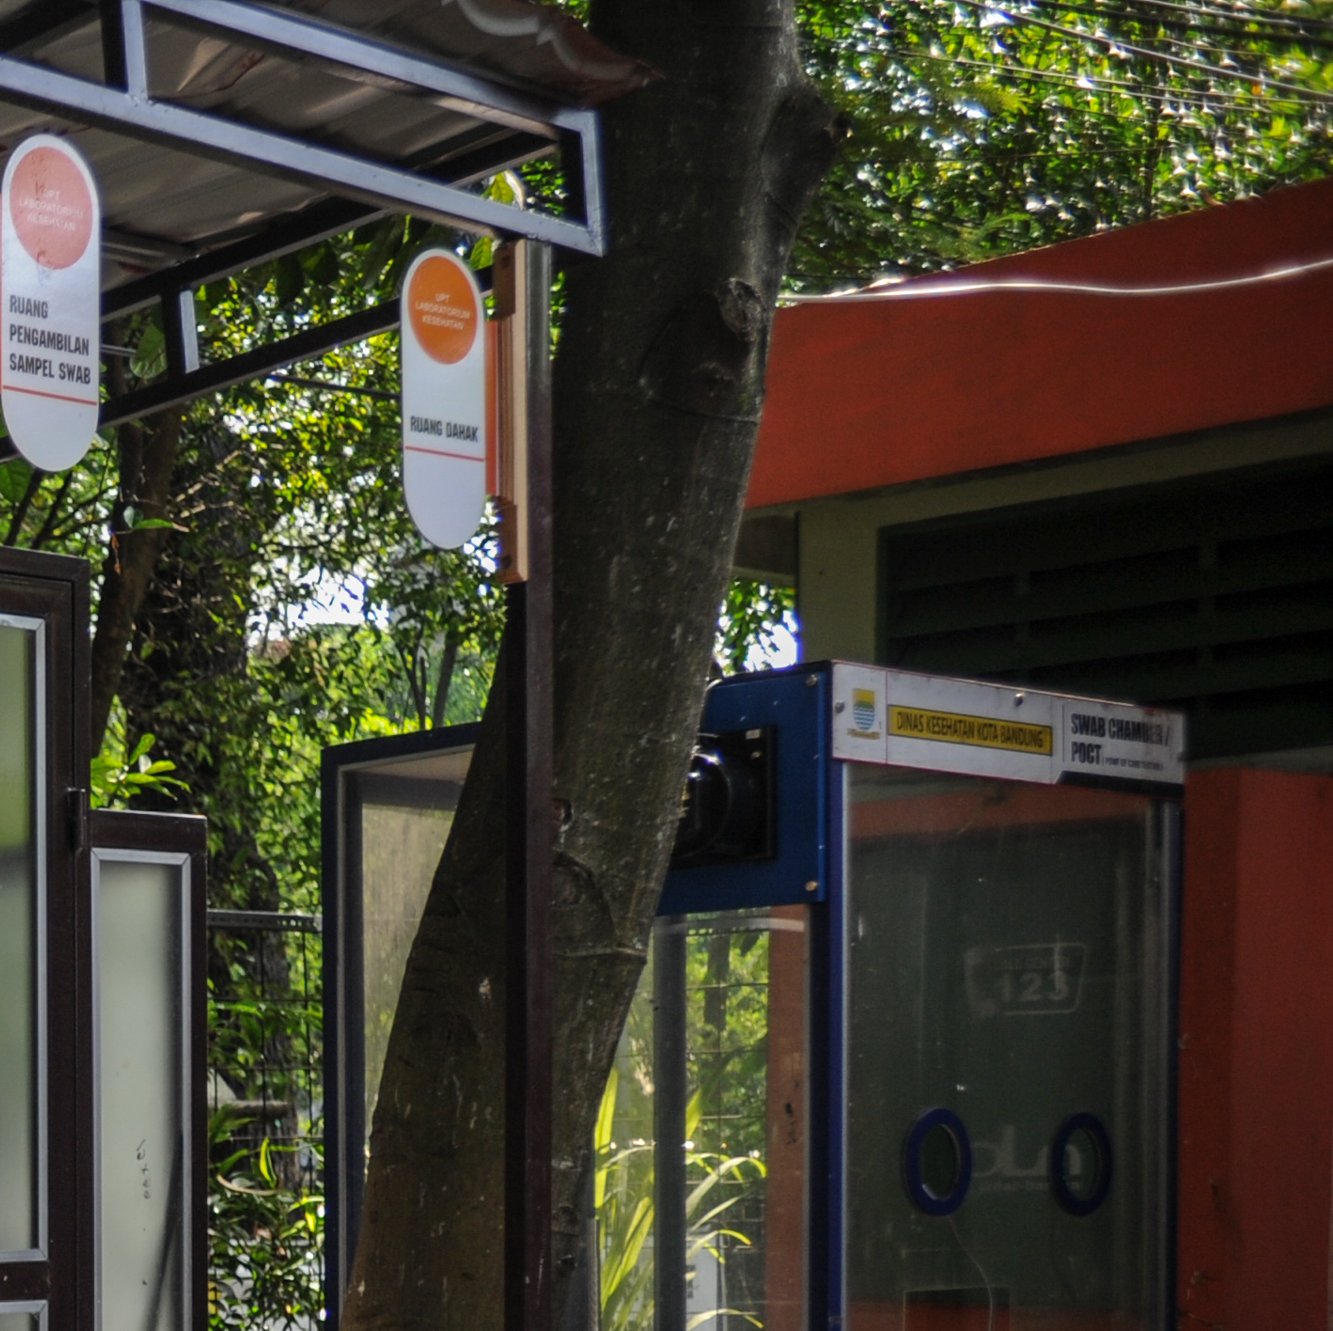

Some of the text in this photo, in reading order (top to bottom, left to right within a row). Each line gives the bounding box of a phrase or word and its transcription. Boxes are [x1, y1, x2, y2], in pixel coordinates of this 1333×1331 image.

[9, 295, 49, 319] RUANG
[422, 314, 465, 331] KESEHATAN
[9, 324, 90, 356] PENGAMBILAN
[9, 355, 91, 384] SAMPEL SWAB
[410, 416, 479, 442] RUANG DAHAK
[897, 711, 1044, 748] DINAS KESEHATAN KOTA BANDUNG
[1071, 713, 1106, 738] SWAB
[1071, 741, 1102, 765] POCT
[995, 971, 1070, 1001] 123
